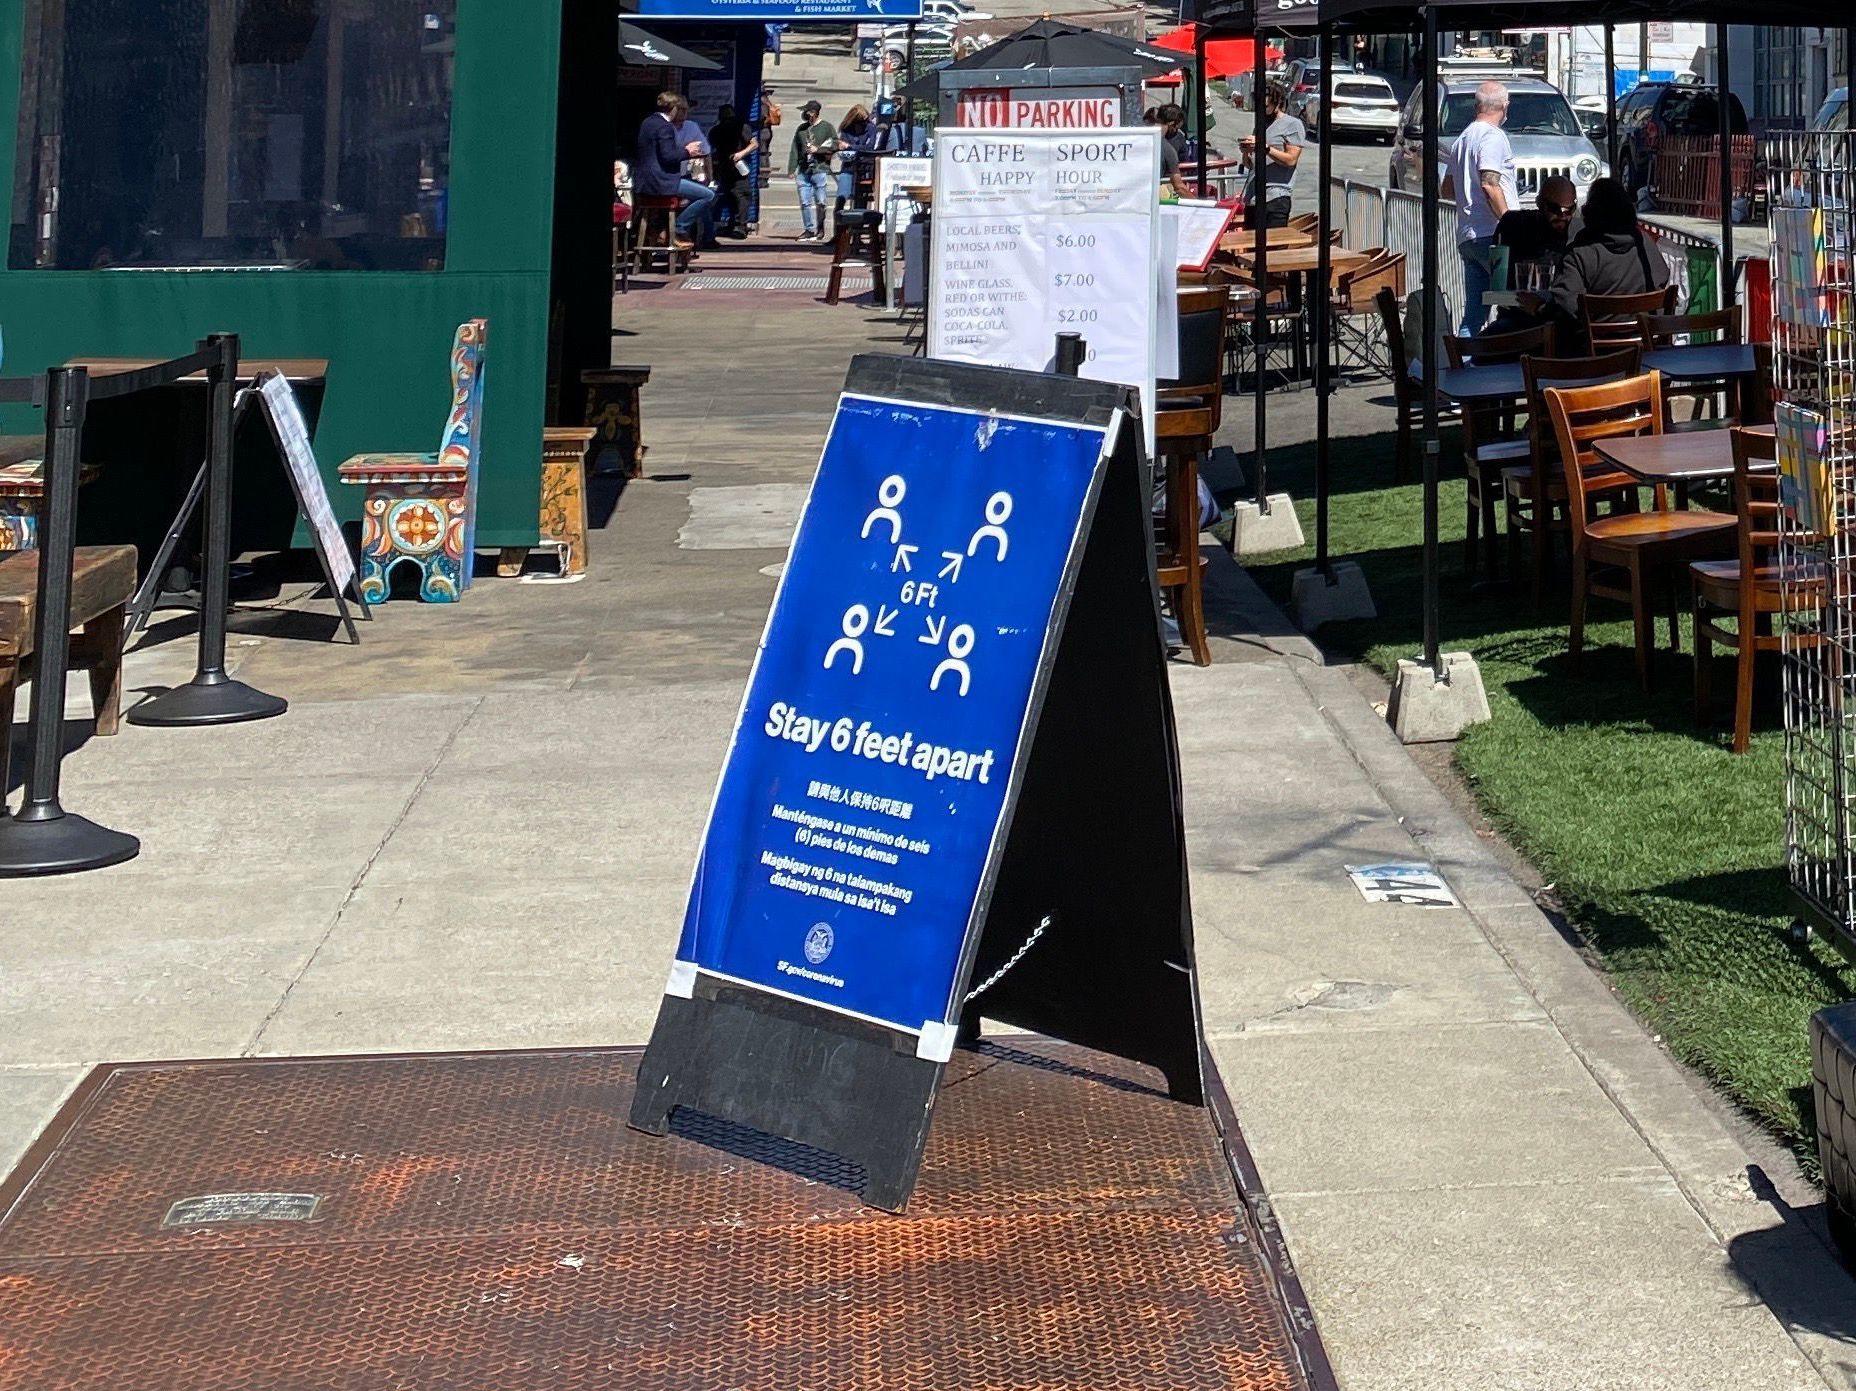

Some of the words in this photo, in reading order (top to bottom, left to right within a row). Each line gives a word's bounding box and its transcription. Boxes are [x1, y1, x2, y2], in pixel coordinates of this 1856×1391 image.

[803, 5, 822, 13] FISH
[823, 5, 856, 13] MARKET
[962, 94, 1004, 128] NO
[1016, 99, 1114, 129] PARKING
[951, 144, 1026, 164] CAFFE
[1056, 143, 1133, 163] SPORT
[980, 171, 1036, 186] HAPPY
[1056, 170, 1102, 185] HOUR
[946, 224, 982, 237] LOCAL
[946, 241, 991, 253] MIMOSA
[995, 240, 1017, 251] AND
[1055, 234, 1096, 249] $6.00
[946, 260, 989, 271] BELLINI
[945, 279, 976, 290] WINE
[1054, 273, 1095, 288] $7.00
[944, 292, 968, 304] RED
[969, 292, 987, 303] OR
[944, 307, 981, 319] SODAS
[982, 307, 1005, 317] CAN
[1058, 308, 1099, 323] $2.00
[900, 580, 916, 604] 6
[914, 581, 939, 609] Ft
[764, 701, 832, 753] Stay
[830, 716, 853, 752] 6
[852, 720, 913, 767] feet
[911, 741, 995, 785] apart
[772, 803, 833, 832] Manténgase
[833, 821, 841, 832] a
[841, 823, 855, 837] un
[855, 827, 894, 847] mínimo
[894, 835, 908, 849] de
[908, 839, 931, 855] seis
[795, 827, 812, 845] (6)
[810, 832, 832, 849] pies
[832, 837, 847, 852] de
[846, 840, 863, 856] los
[863, 844, 899, 865] demas
[760, 850, 812, 876] Magbigay
[811, 864, 825, 881] ng
[825, 867, 833, 881] 6
[832, 872, 846, 885] na
[846, 872, 913, 904] talampakang
[769, 872, 819, 896] distansya
[819, 885, 845, 902] mula
[844, 893, 858, 906] sa
[880, 900, 897, 916] isa
